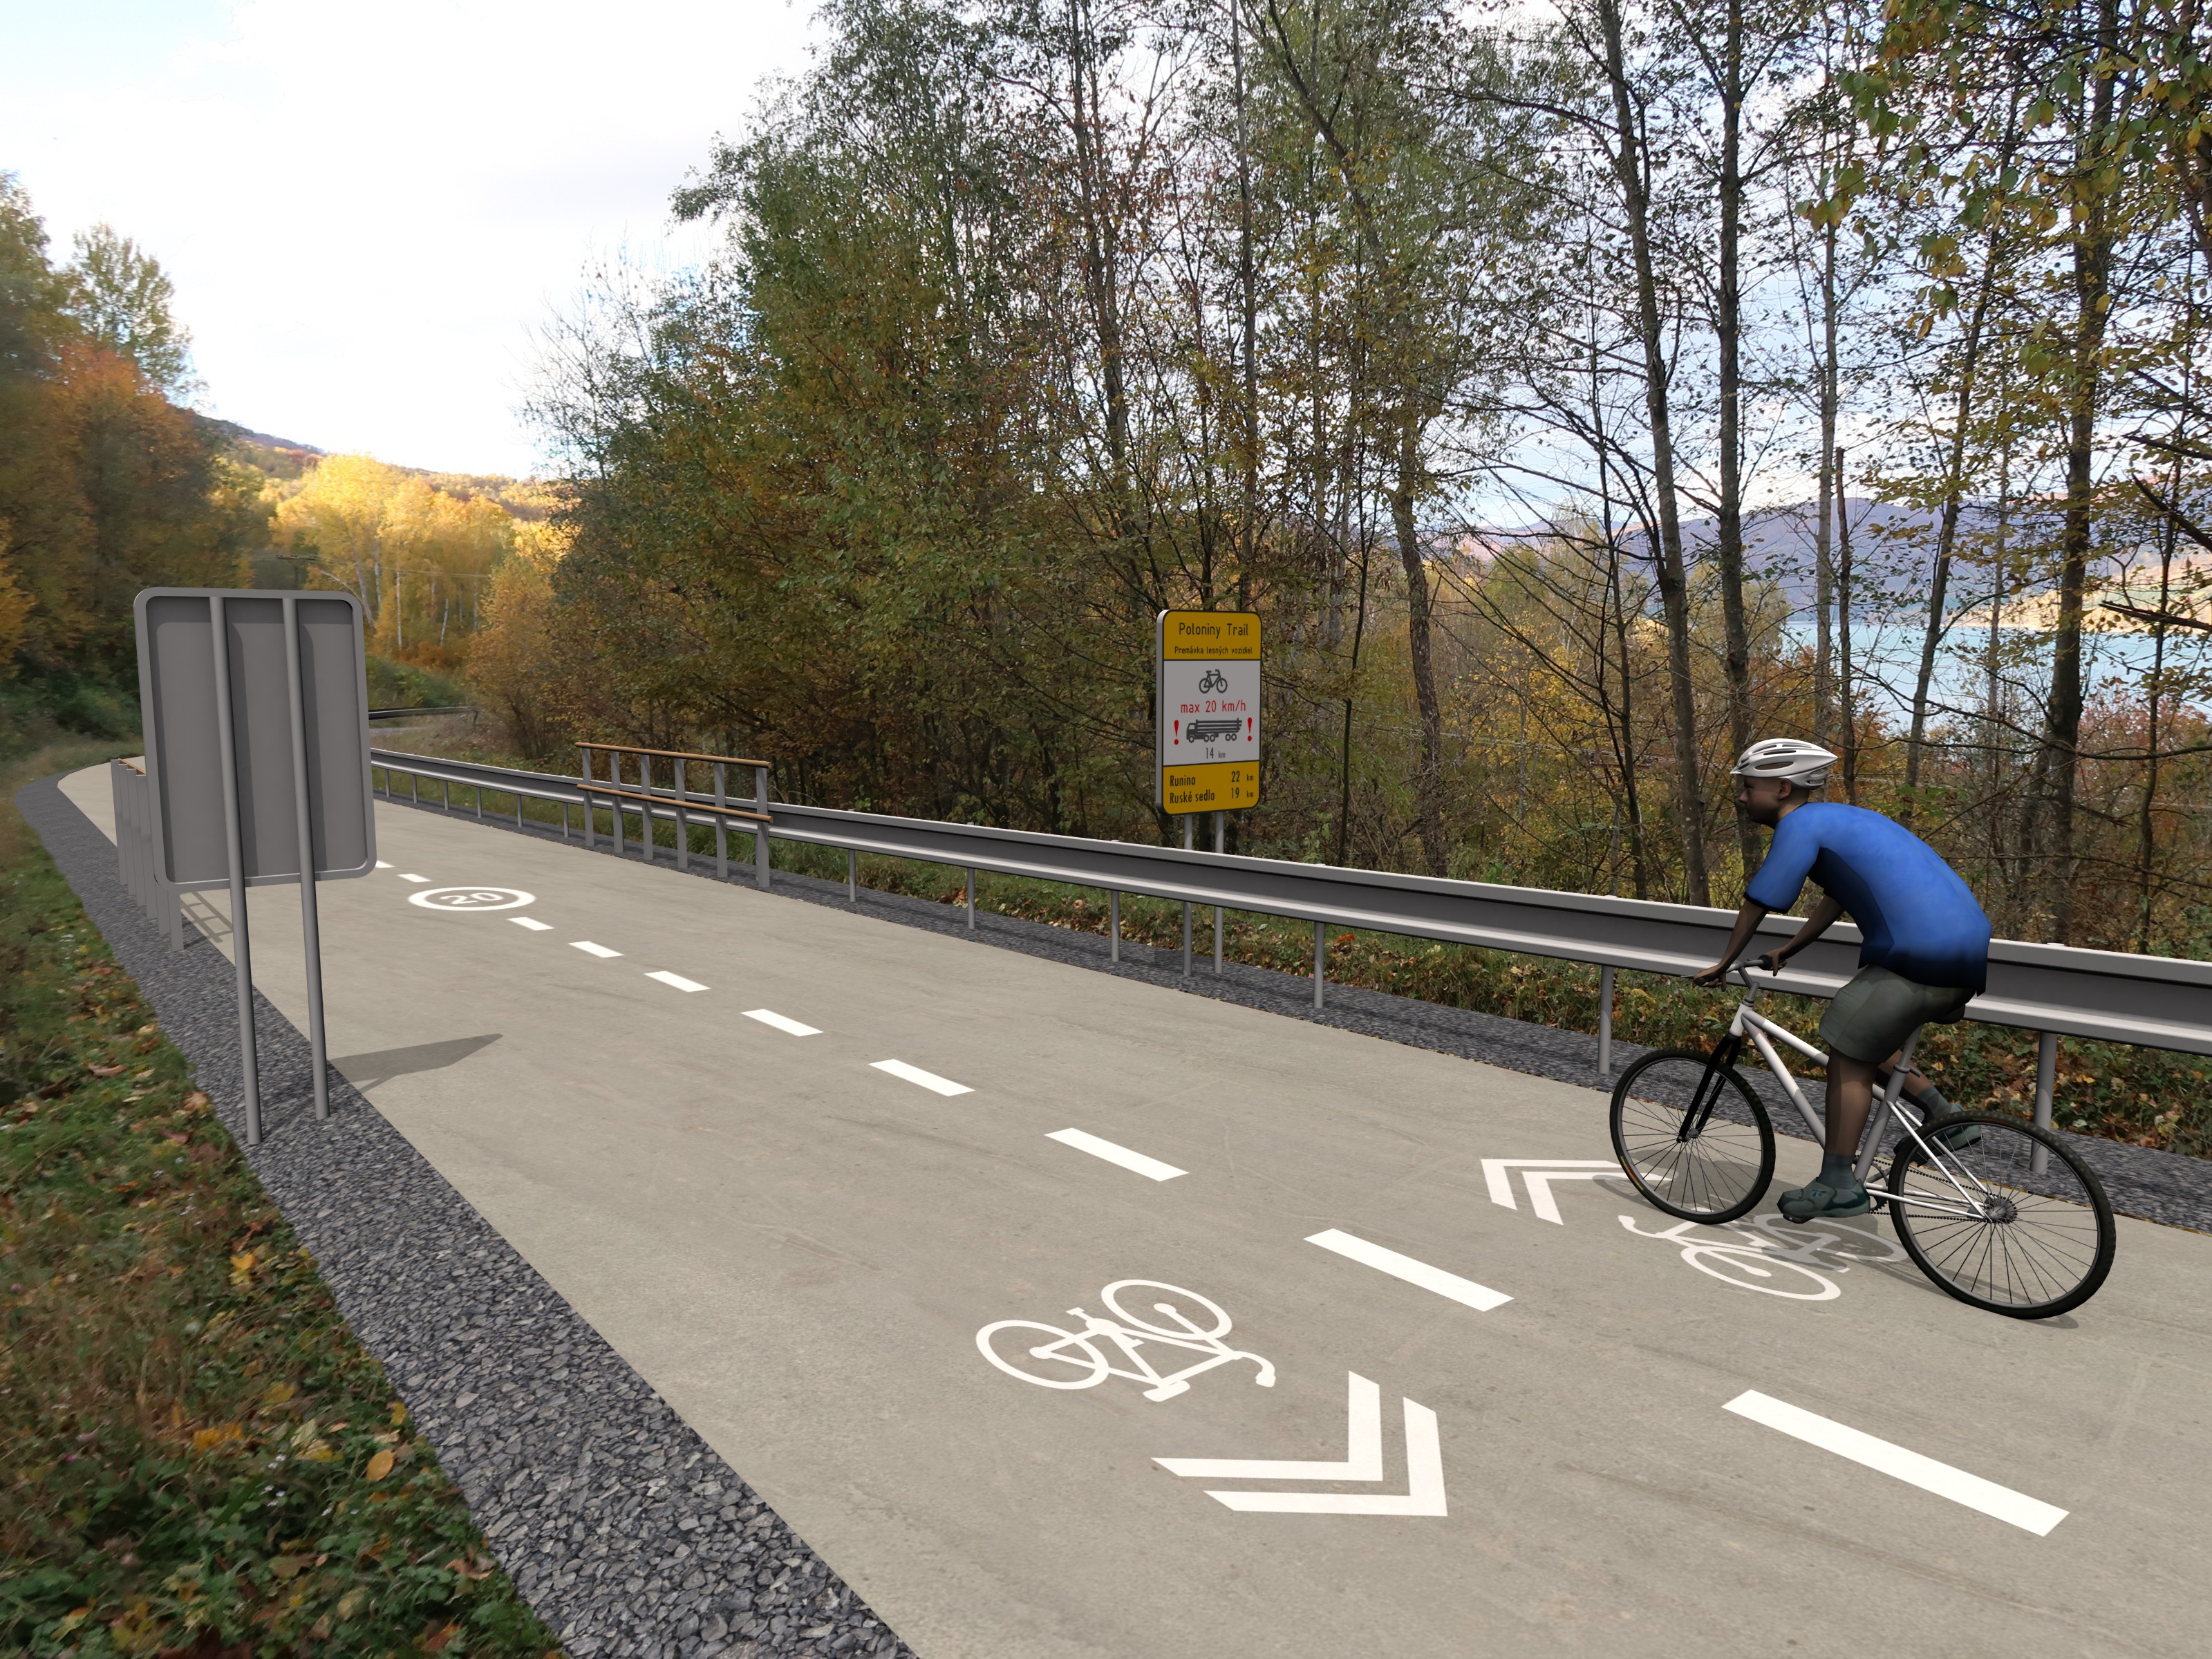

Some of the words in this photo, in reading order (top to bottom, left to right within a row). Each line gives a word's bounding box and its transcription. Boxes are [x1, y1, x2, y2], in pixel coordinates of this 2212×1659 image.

[1179, 623, 1221, 639] Poloniny
[1227, 624, 1248, 635] Trail
[1174, 646, 1203, 654] Premávka
[1206, 646, 1228, 656] lesných
[1181, 704, 1199, 713] max
[1206, 700, 1217, 713] 20
[1222, 700, 1246, 712] km/h
[1206, 747, 1214, 759] 14
[1170, 775, 1195, 787] Runina
[1231, 771, 1240, 782] 22
[1170, 791, 1192, 804] Ruské
[1195, 789, 1215, 802] sedlo
[1231, 787, 1239, 799] 19
[439, 892, 504, 905] 20
